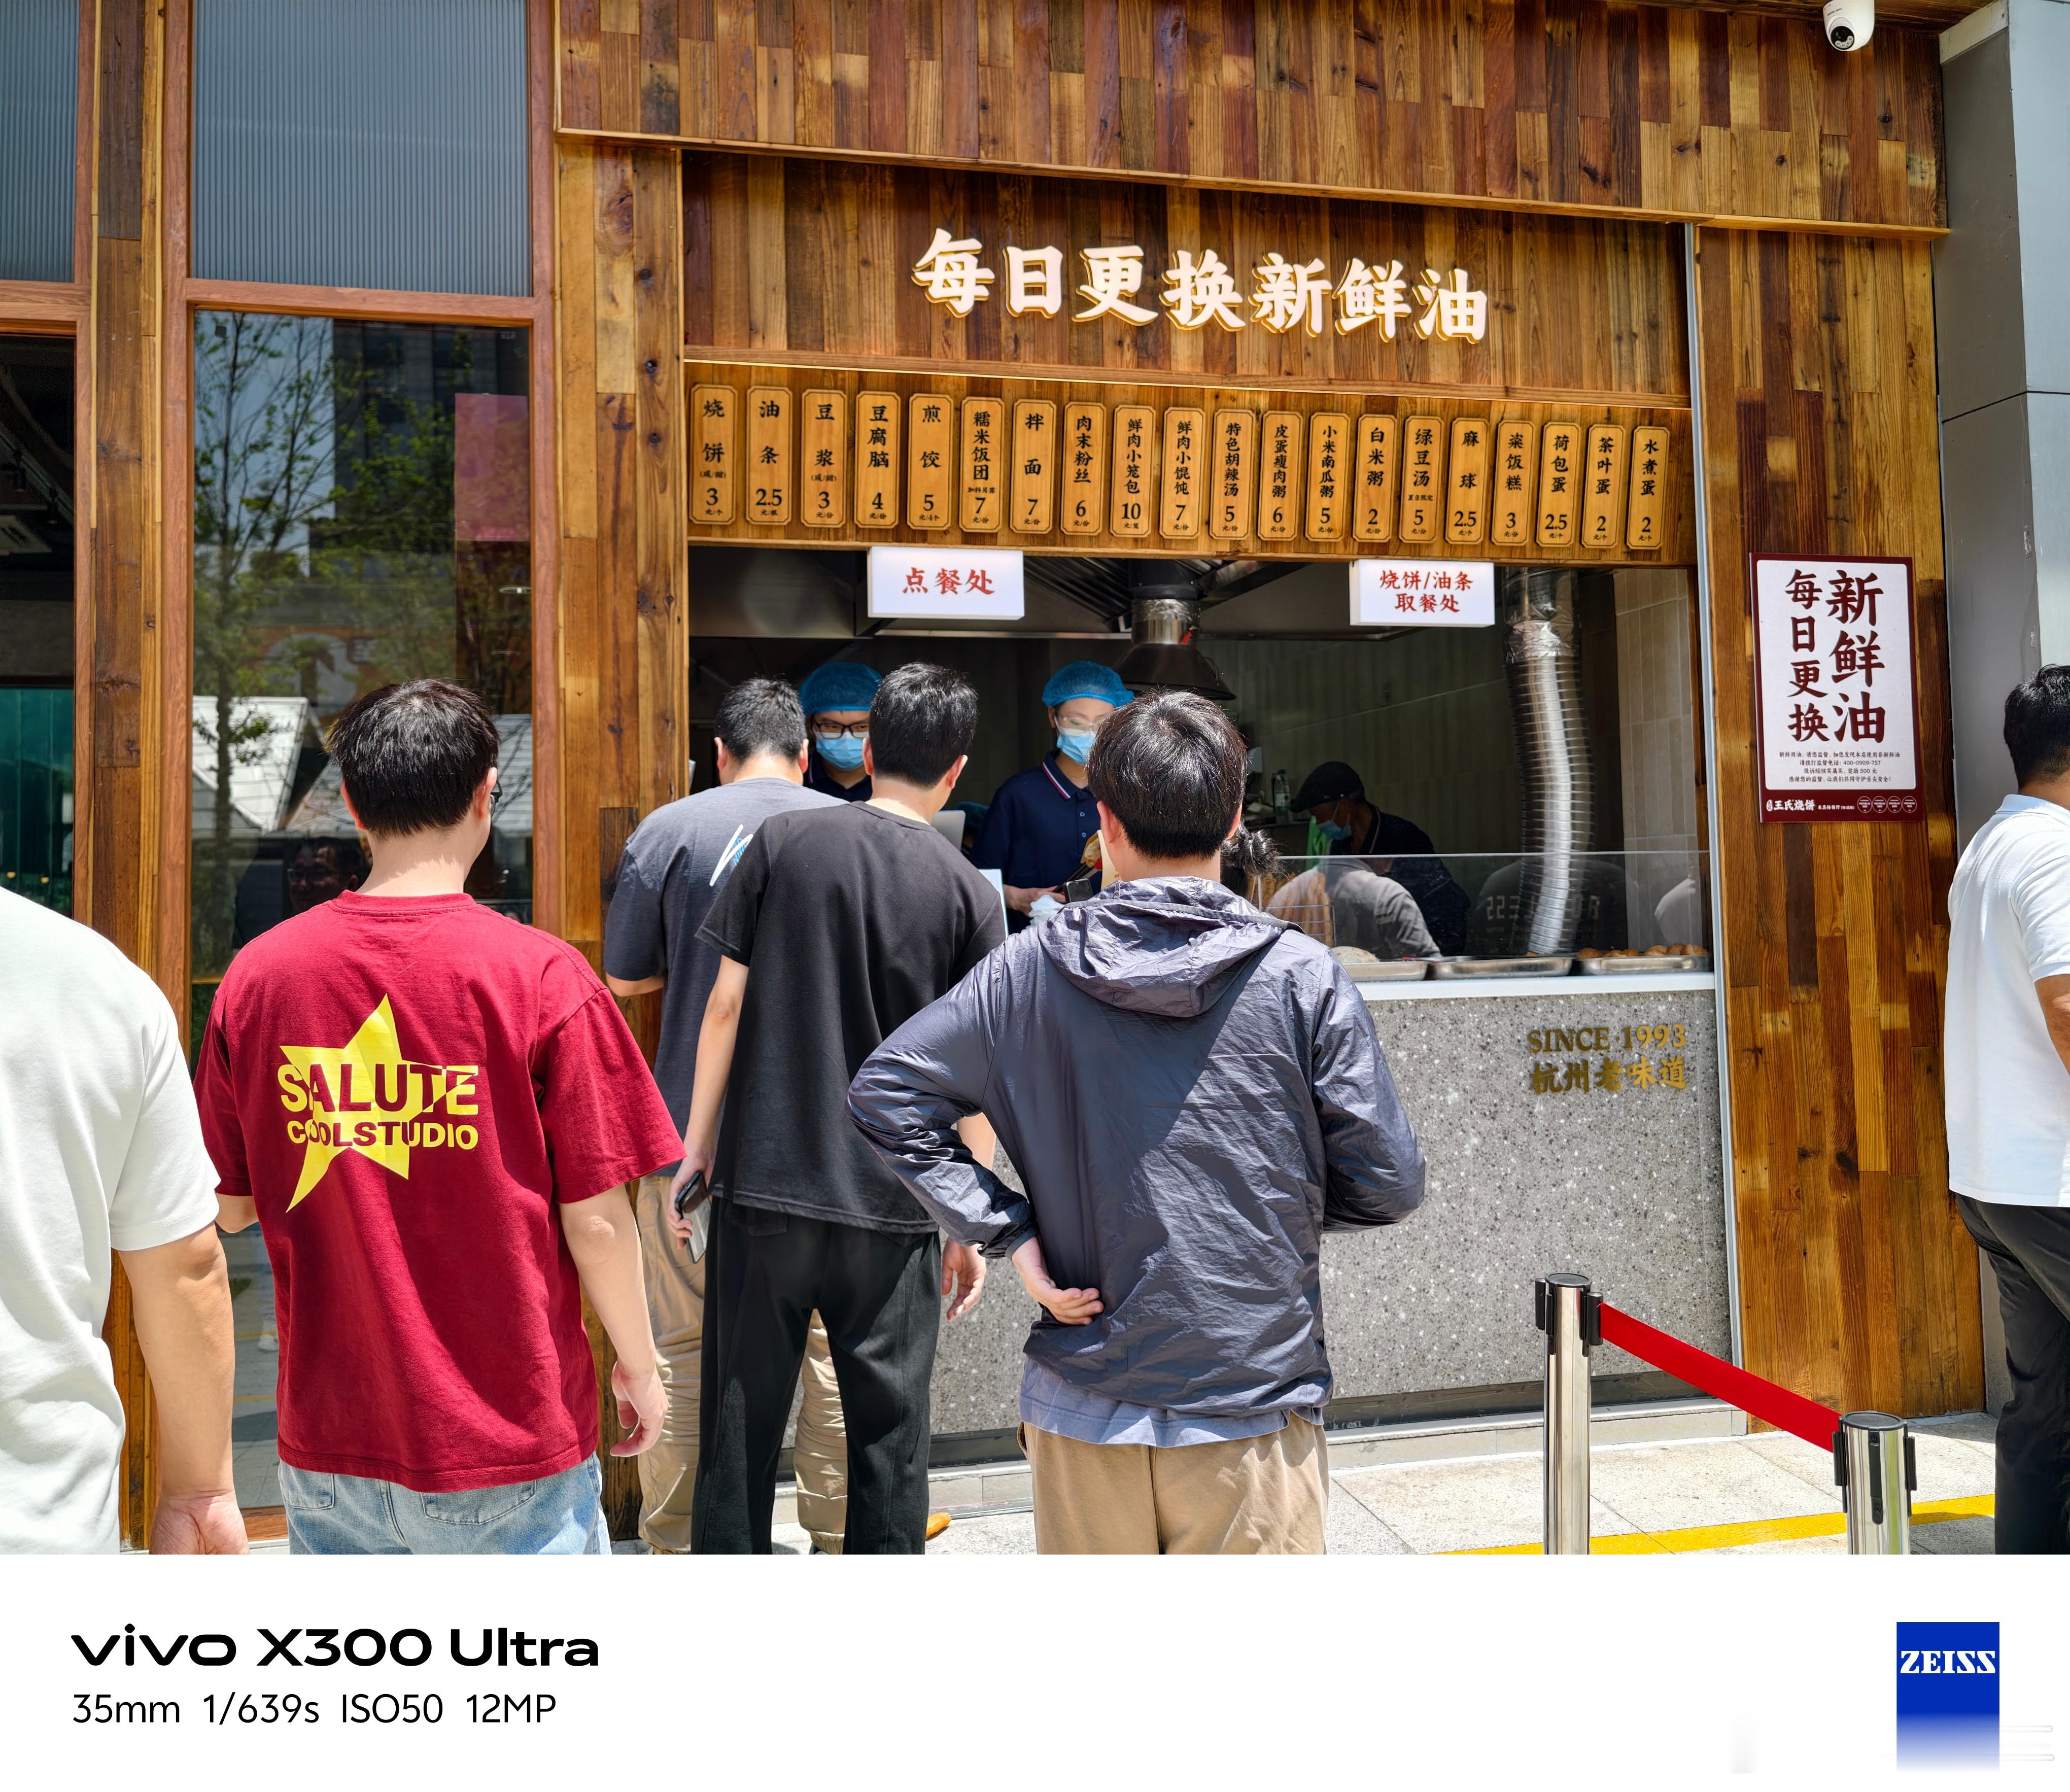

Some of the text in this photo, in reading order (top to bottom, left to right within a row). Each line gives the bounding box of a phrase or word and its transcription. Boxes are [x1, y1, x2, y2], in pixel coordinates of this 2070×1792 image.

[913, 228, 1488, 342] 每日更换新鲜油
[867, 405, 889, 468] 豆腐脑
[972, 411, 991, 481] 糯米饭团
[1073, 415, 1094, 483] 肉末粉丝
[1124, 418, 1143, 494] 鲜肉小笼包
[1174, 421, 1192, 495] 鲜肉小馄饨
[1366, 427, 1385, 487] 白米粥
[1413, 428, 1433, 487] 绿豆汤
[1224, 422, 1241, 497] 特色胡辣汤
[1272, 424, 1289, 499] 皮蛋瘦肉粥
[1319, 425, 1337, 499] 小米南瓜粥
[1505, 432, 1524, 491] 粢饭糕
[1551, 434, 1569, 493] 荷包蛋
[1595, 436, 1614, 495] 茶叶蛋
[1640, 439, 1660, 496] 水煮蛋
[706, 488, 718, 506] 3
[755, 488, 782, 506] 2.5
[818, 491, 830, 509] 3
[872, 492, 883, 510] 4
[923, 494, 934, 511] 5
[975, 497, 986, 514] 7
[1027, 498, 1039, 515] 7
[1076, 500, 1086, 517] 6
[1121, 503, 1141, 520] 10
[1176, 504, 1186, 521] 7
[1224, 505, 1235, 522] 5
[1272, 506, 1283, 523] 6
[1320, 507, 1330, 524] 5
[1368, 508, 1378, 525] 2
[1413, 509, 1424, 526] 5
[1454, 510, 1476, 527] 2.5
[1506, 512, 1516, 529] 3
[1544, 513, 1567, 530] 2.5
[1596, 515, 1606, 532] 2
[1641, 516, 1651, 533] 2
[904, 568, 992, 594] 点餐处
[1381, 571, 1472, 591] 烧饼/油条
[1396, 594, 1458, 612] 取餐处
[1784, 569, 1830, 742] 每日更换
[1825, 569, 1885, 743] 新鲜油
[1527, 1023, 1686, 1053] SINCE 1993
[1529, 1055, 1688, 1095] 杭州老味道
[278, 1063, 478, 1115] SALUTE
